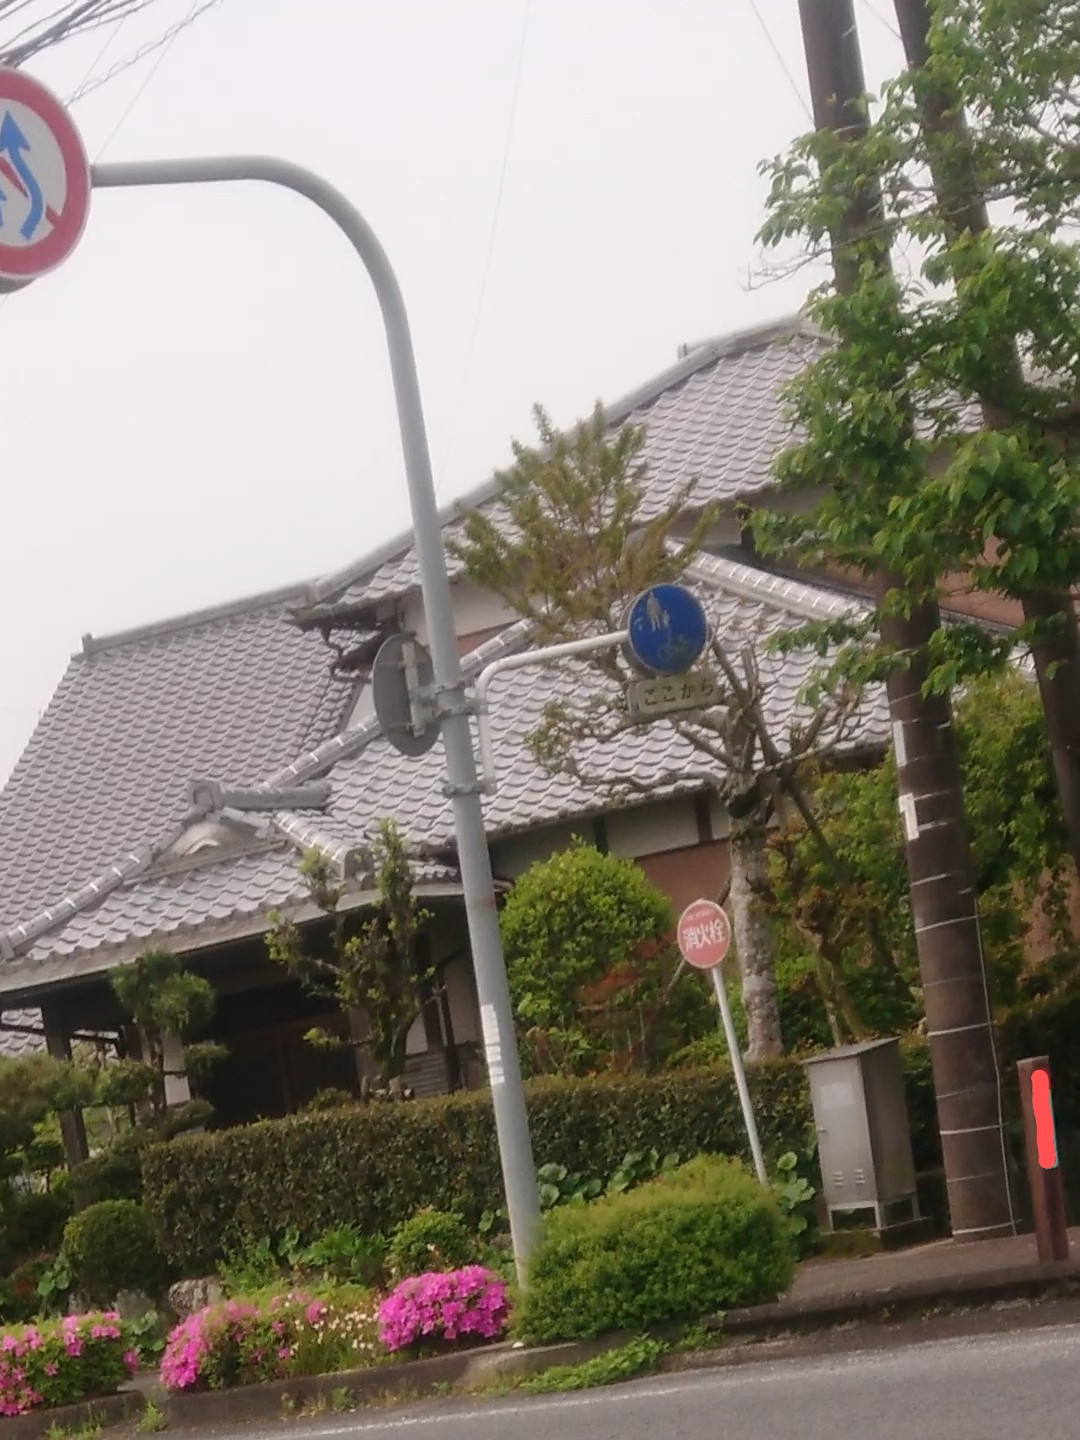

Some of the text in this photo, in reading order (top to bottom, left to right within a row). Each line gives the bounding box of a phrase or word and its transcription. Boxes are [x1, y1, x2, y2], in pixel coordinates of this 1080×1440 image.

[643, 677, 714, 706] ここから
[681, 918, 725, 953] 消火栓
